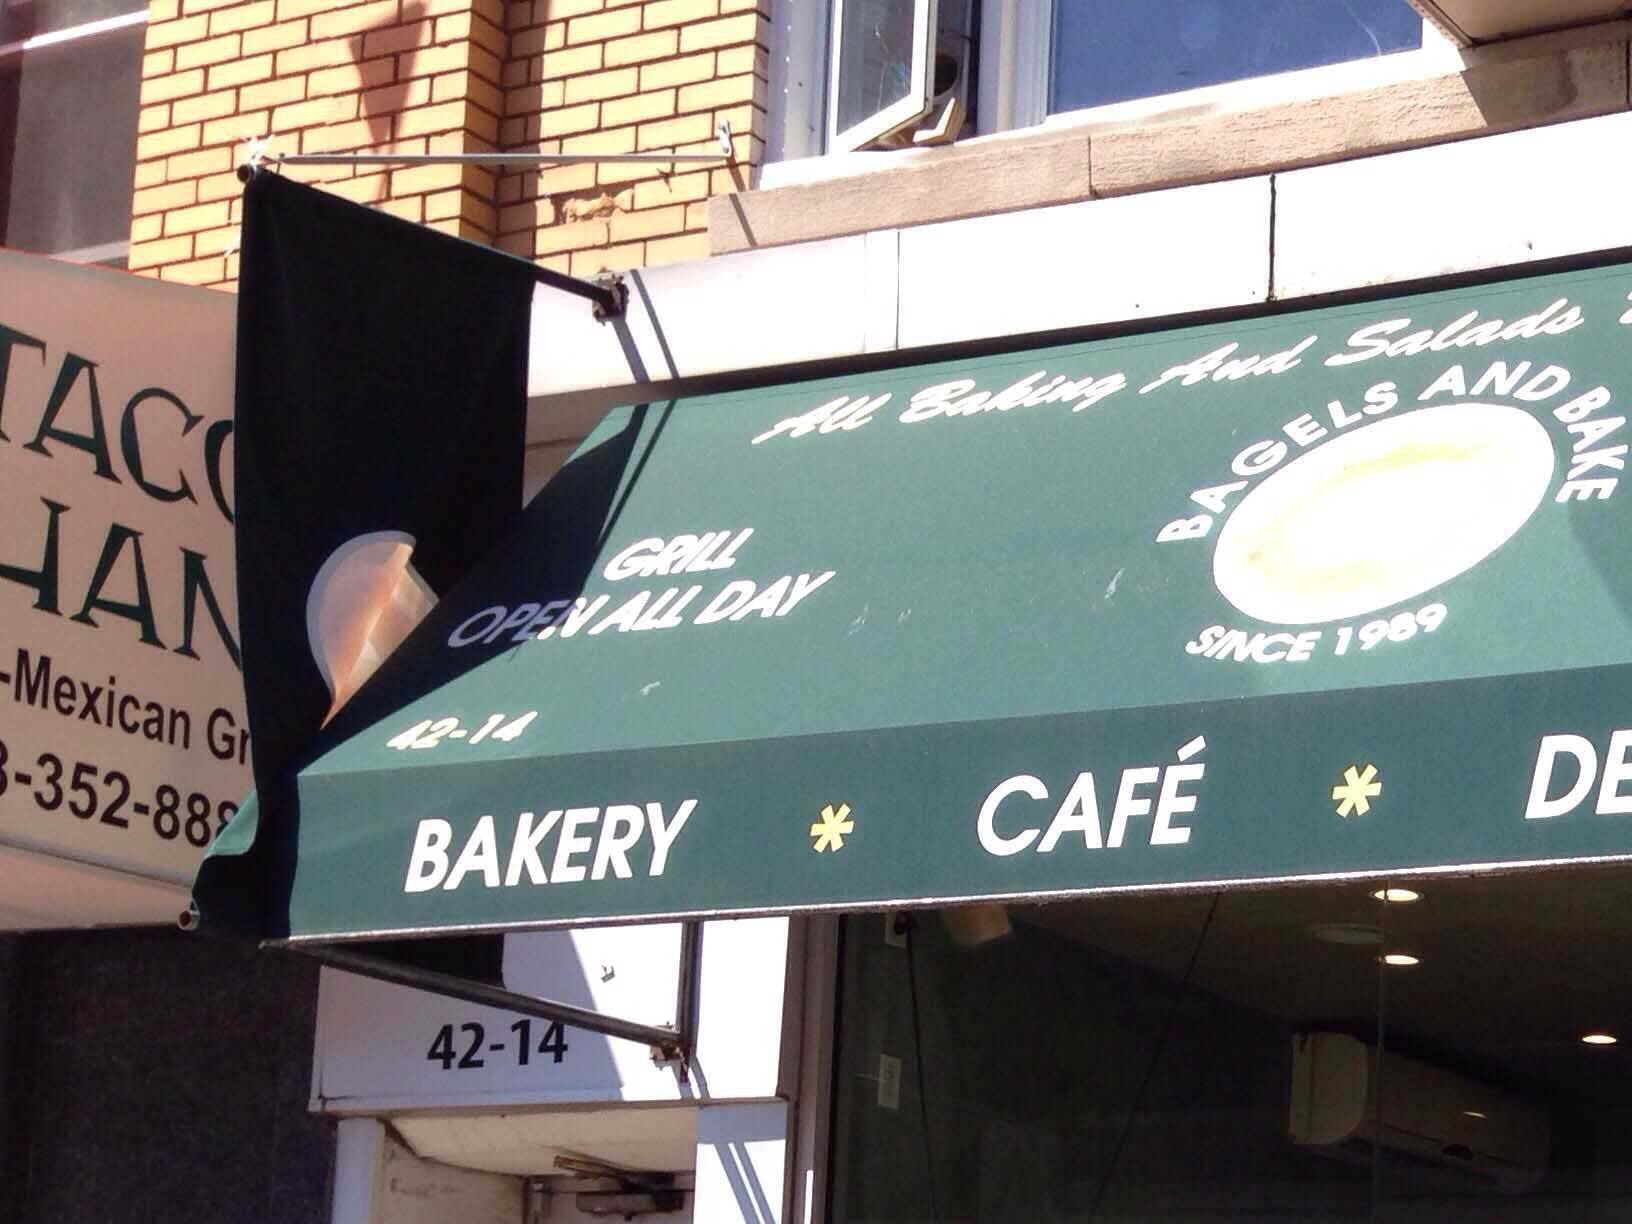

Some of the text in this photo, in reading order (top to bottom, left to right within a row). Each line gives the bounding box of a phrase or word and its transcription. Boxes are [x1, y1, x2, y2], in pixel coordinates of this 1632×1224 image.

[752, 392, 892, 445] All
[900, 370, 1127, 423] Baking
[1140, 335, 1318, 394] And
[1325, 298, 1585, 366] Salads
[1156, 360, 1628, 543] BAGELS AND BAKE
[604, 527, 754, 580] GRILL
[447, 571, 837, 648] OPEN ALL DAY
[1185, 603, 1448, 664] SINCE 1989
[387, 711, 538, 750] 42-14
[976, 735, 1206, 857] CAFÉ
[403, 798, 699, 893] BAKERY
[427, 1019, 568, 1070] 42-14
